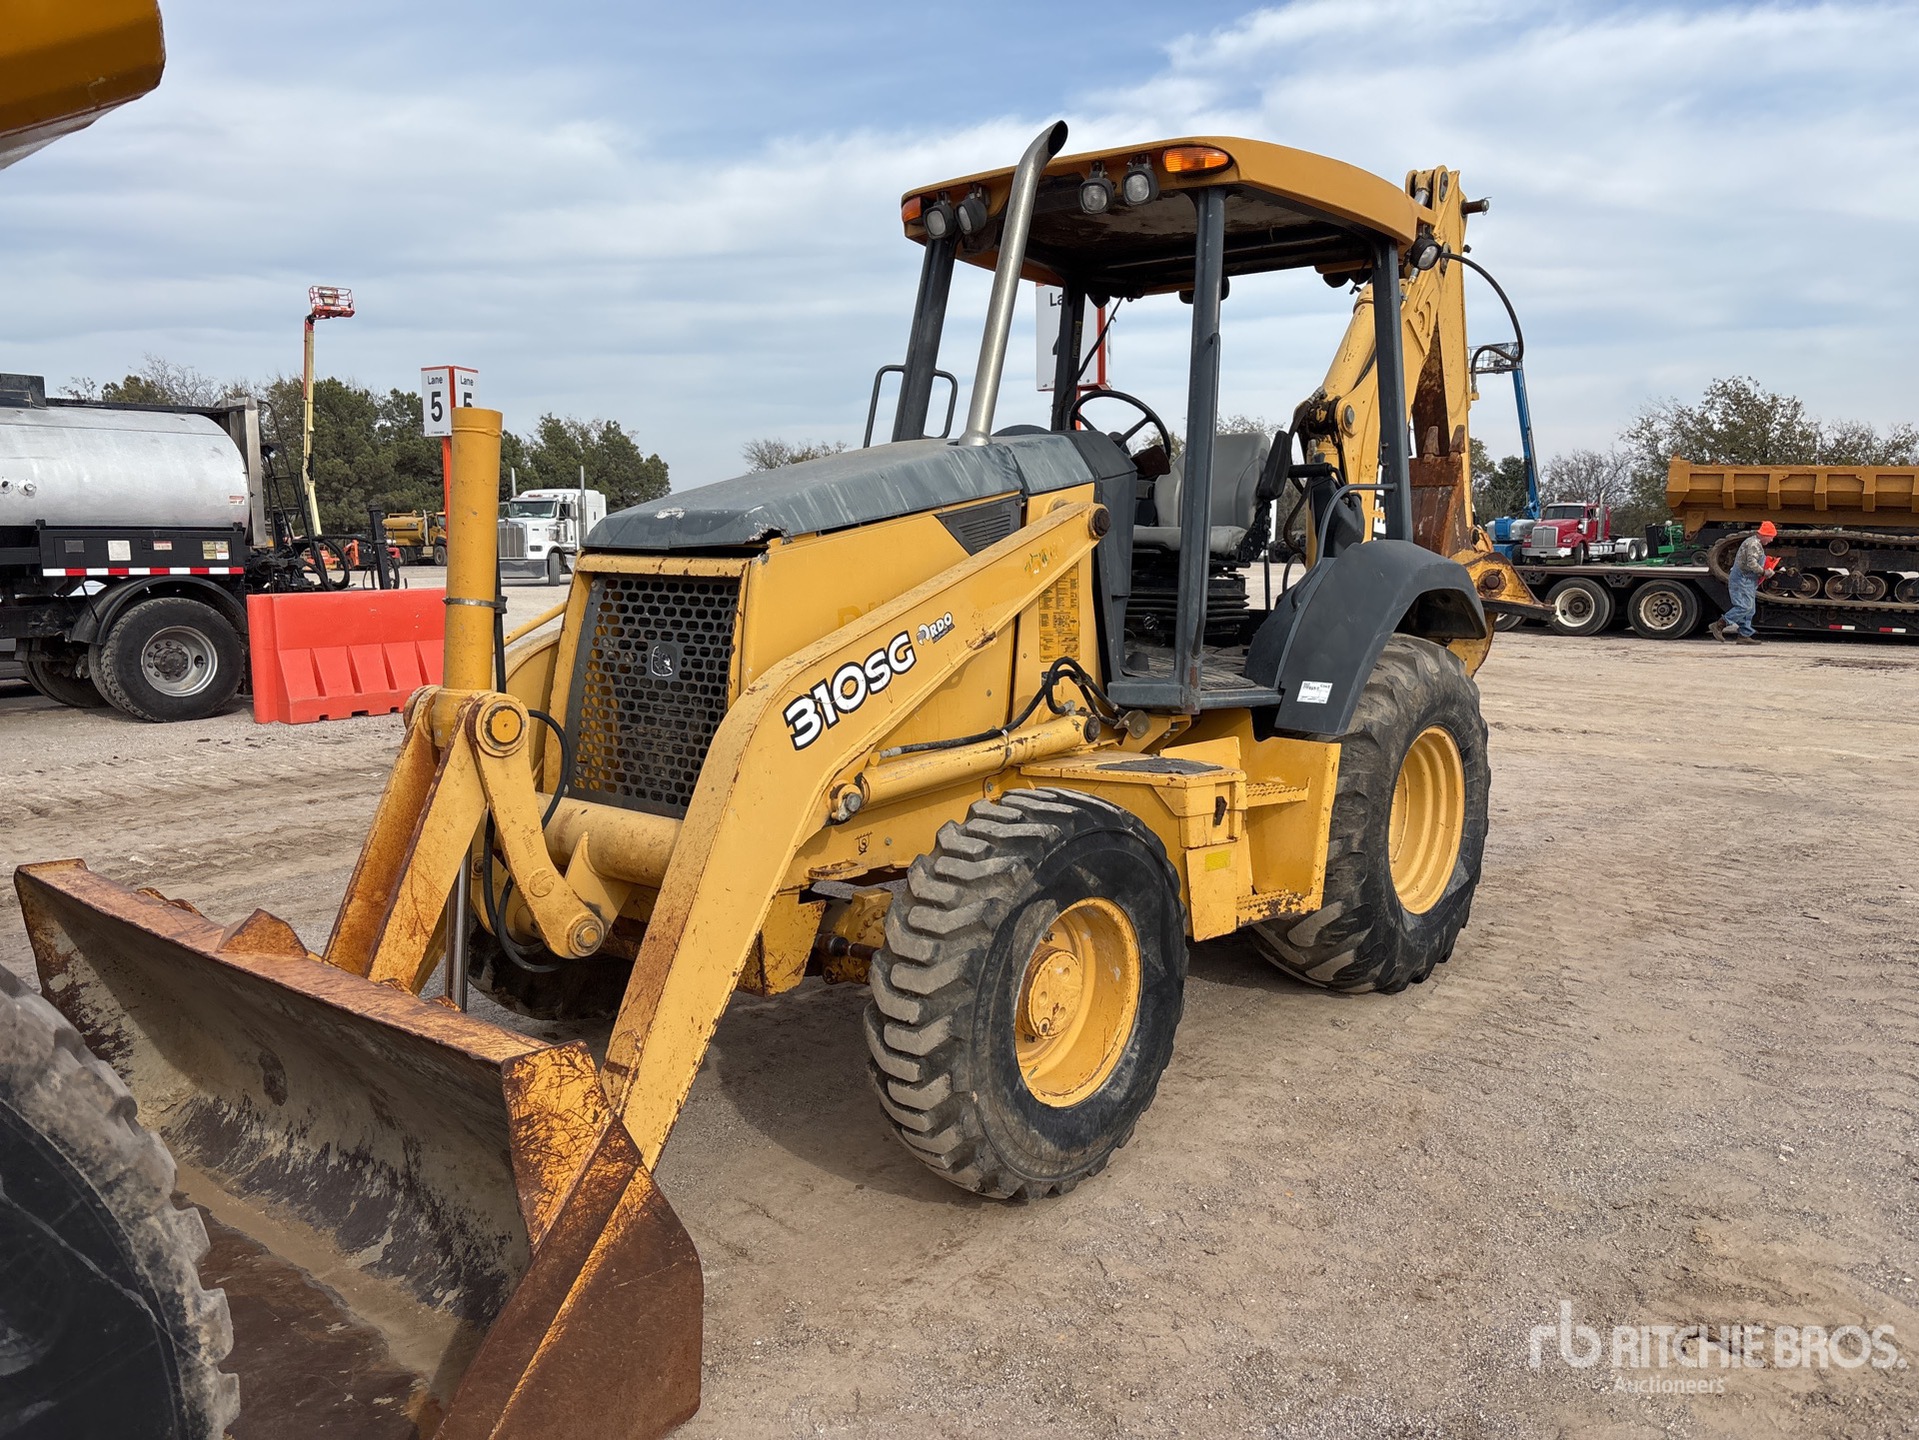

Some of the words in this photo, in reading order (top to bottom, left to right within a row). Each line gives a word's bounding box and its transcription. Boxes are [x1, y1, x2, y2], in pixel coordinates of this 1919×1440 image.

[1049, 292, 1063, 307] La
[427, 375, 444, 385] Lane
[460, 375, 474, 387] Lane
[431, 391, 443, 422] 5
[782, 630, 917, 751] 310SG
